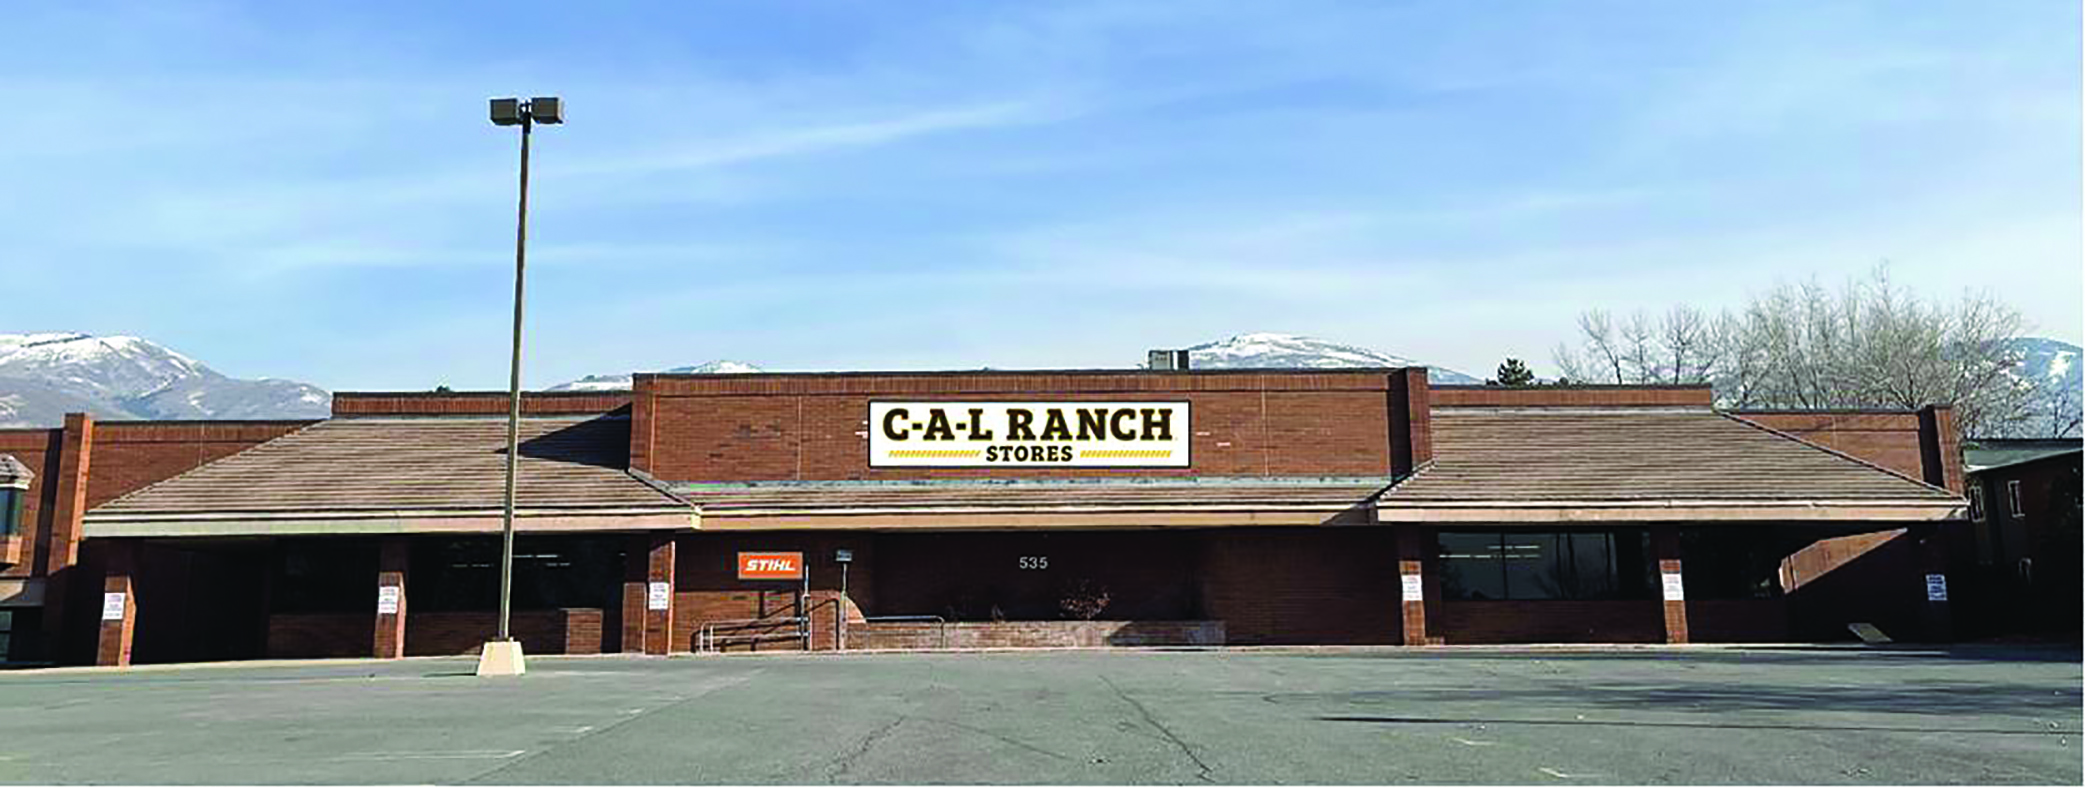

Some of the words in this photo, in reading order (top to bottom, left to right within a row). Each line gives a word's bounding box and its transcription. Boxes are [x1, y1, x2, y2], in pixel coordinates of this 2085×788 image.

[882, 408, 993, 441] C-A-L
[1006, 408, 1173, 441] RANCH
[986, 445, 1073, 462] STORES
[745, 559, 796, 571] STIHL
[1019, 556, 1048, 570] 535
